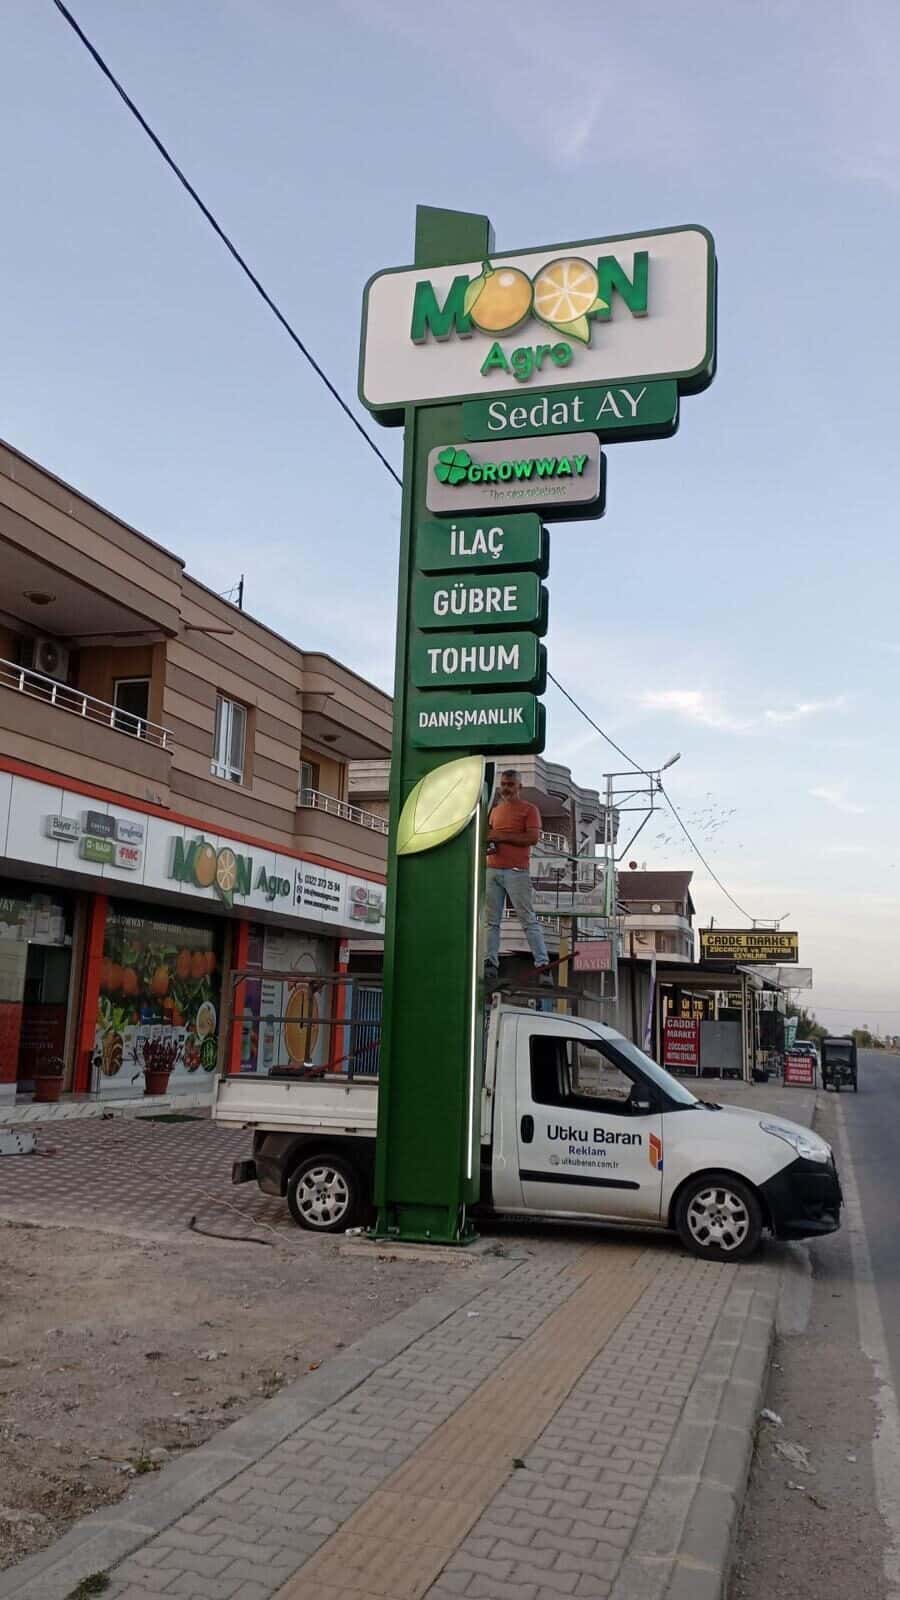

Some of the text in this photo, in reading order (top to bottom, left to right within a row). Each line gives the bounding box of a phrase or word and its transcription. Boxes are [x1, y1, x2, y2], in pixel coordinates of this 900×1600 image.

[480, 342, 573, 382] Agro
[487, 386, 647, 431] Sedat AY
[468, 454, 589, 482] GROWWAY
[450, 525, 504, 559] İLAÇ
[433, 583, 517, 615] GÜBRE
[427, 644, 520, 673] TOHUM
[418, 707, 524, 730] DANIŞMANLIK
[254, 866, 291, 902] Agro
[707, 936, 793, 946] CADDE MARKET
[667, 1019, 696, 1029] CADDE
[667, 1030, 696, 1039] MARKET
[547, 1124, 642, 1145] Utku Baran
[568, 1145, 606, 1157] Reklam
